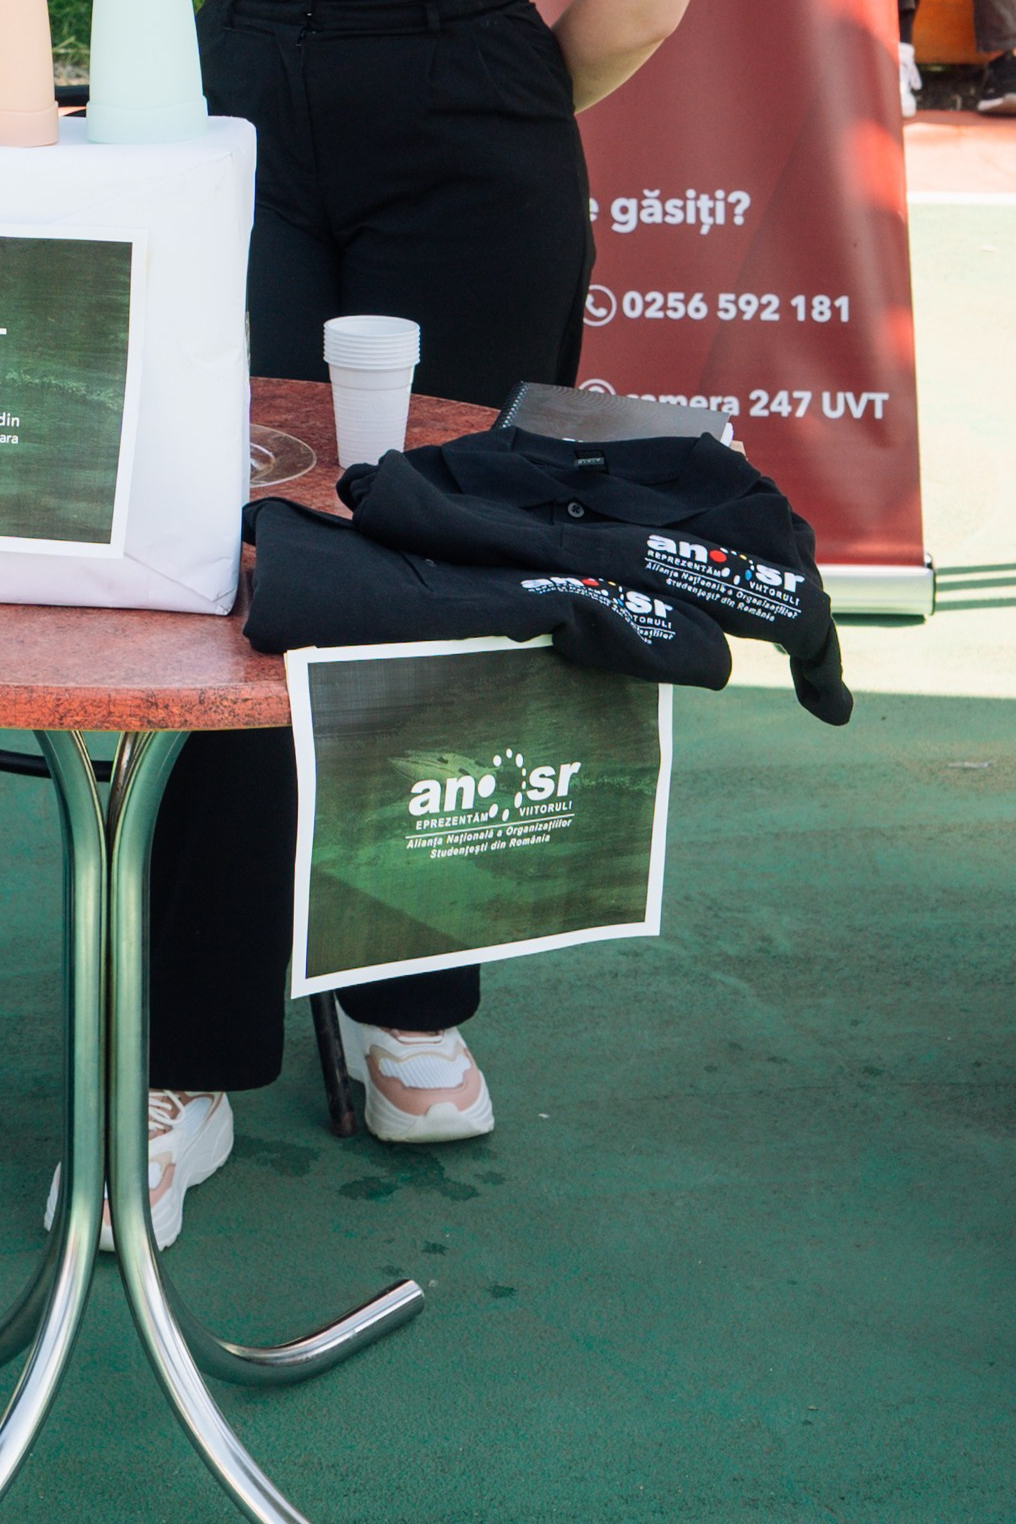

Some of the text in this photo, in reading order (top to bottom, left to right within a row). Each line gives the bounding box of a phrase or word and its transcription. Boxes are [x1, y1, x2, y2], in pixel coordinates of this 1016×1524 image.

[610, 188, 752, 236] găsiți?
[621, 290, 850, 323] 0256 592 181
[748, 389, 813, 418] 247
[821, 390, 890, 420] UVT
[490, 838, 507, 851] din
